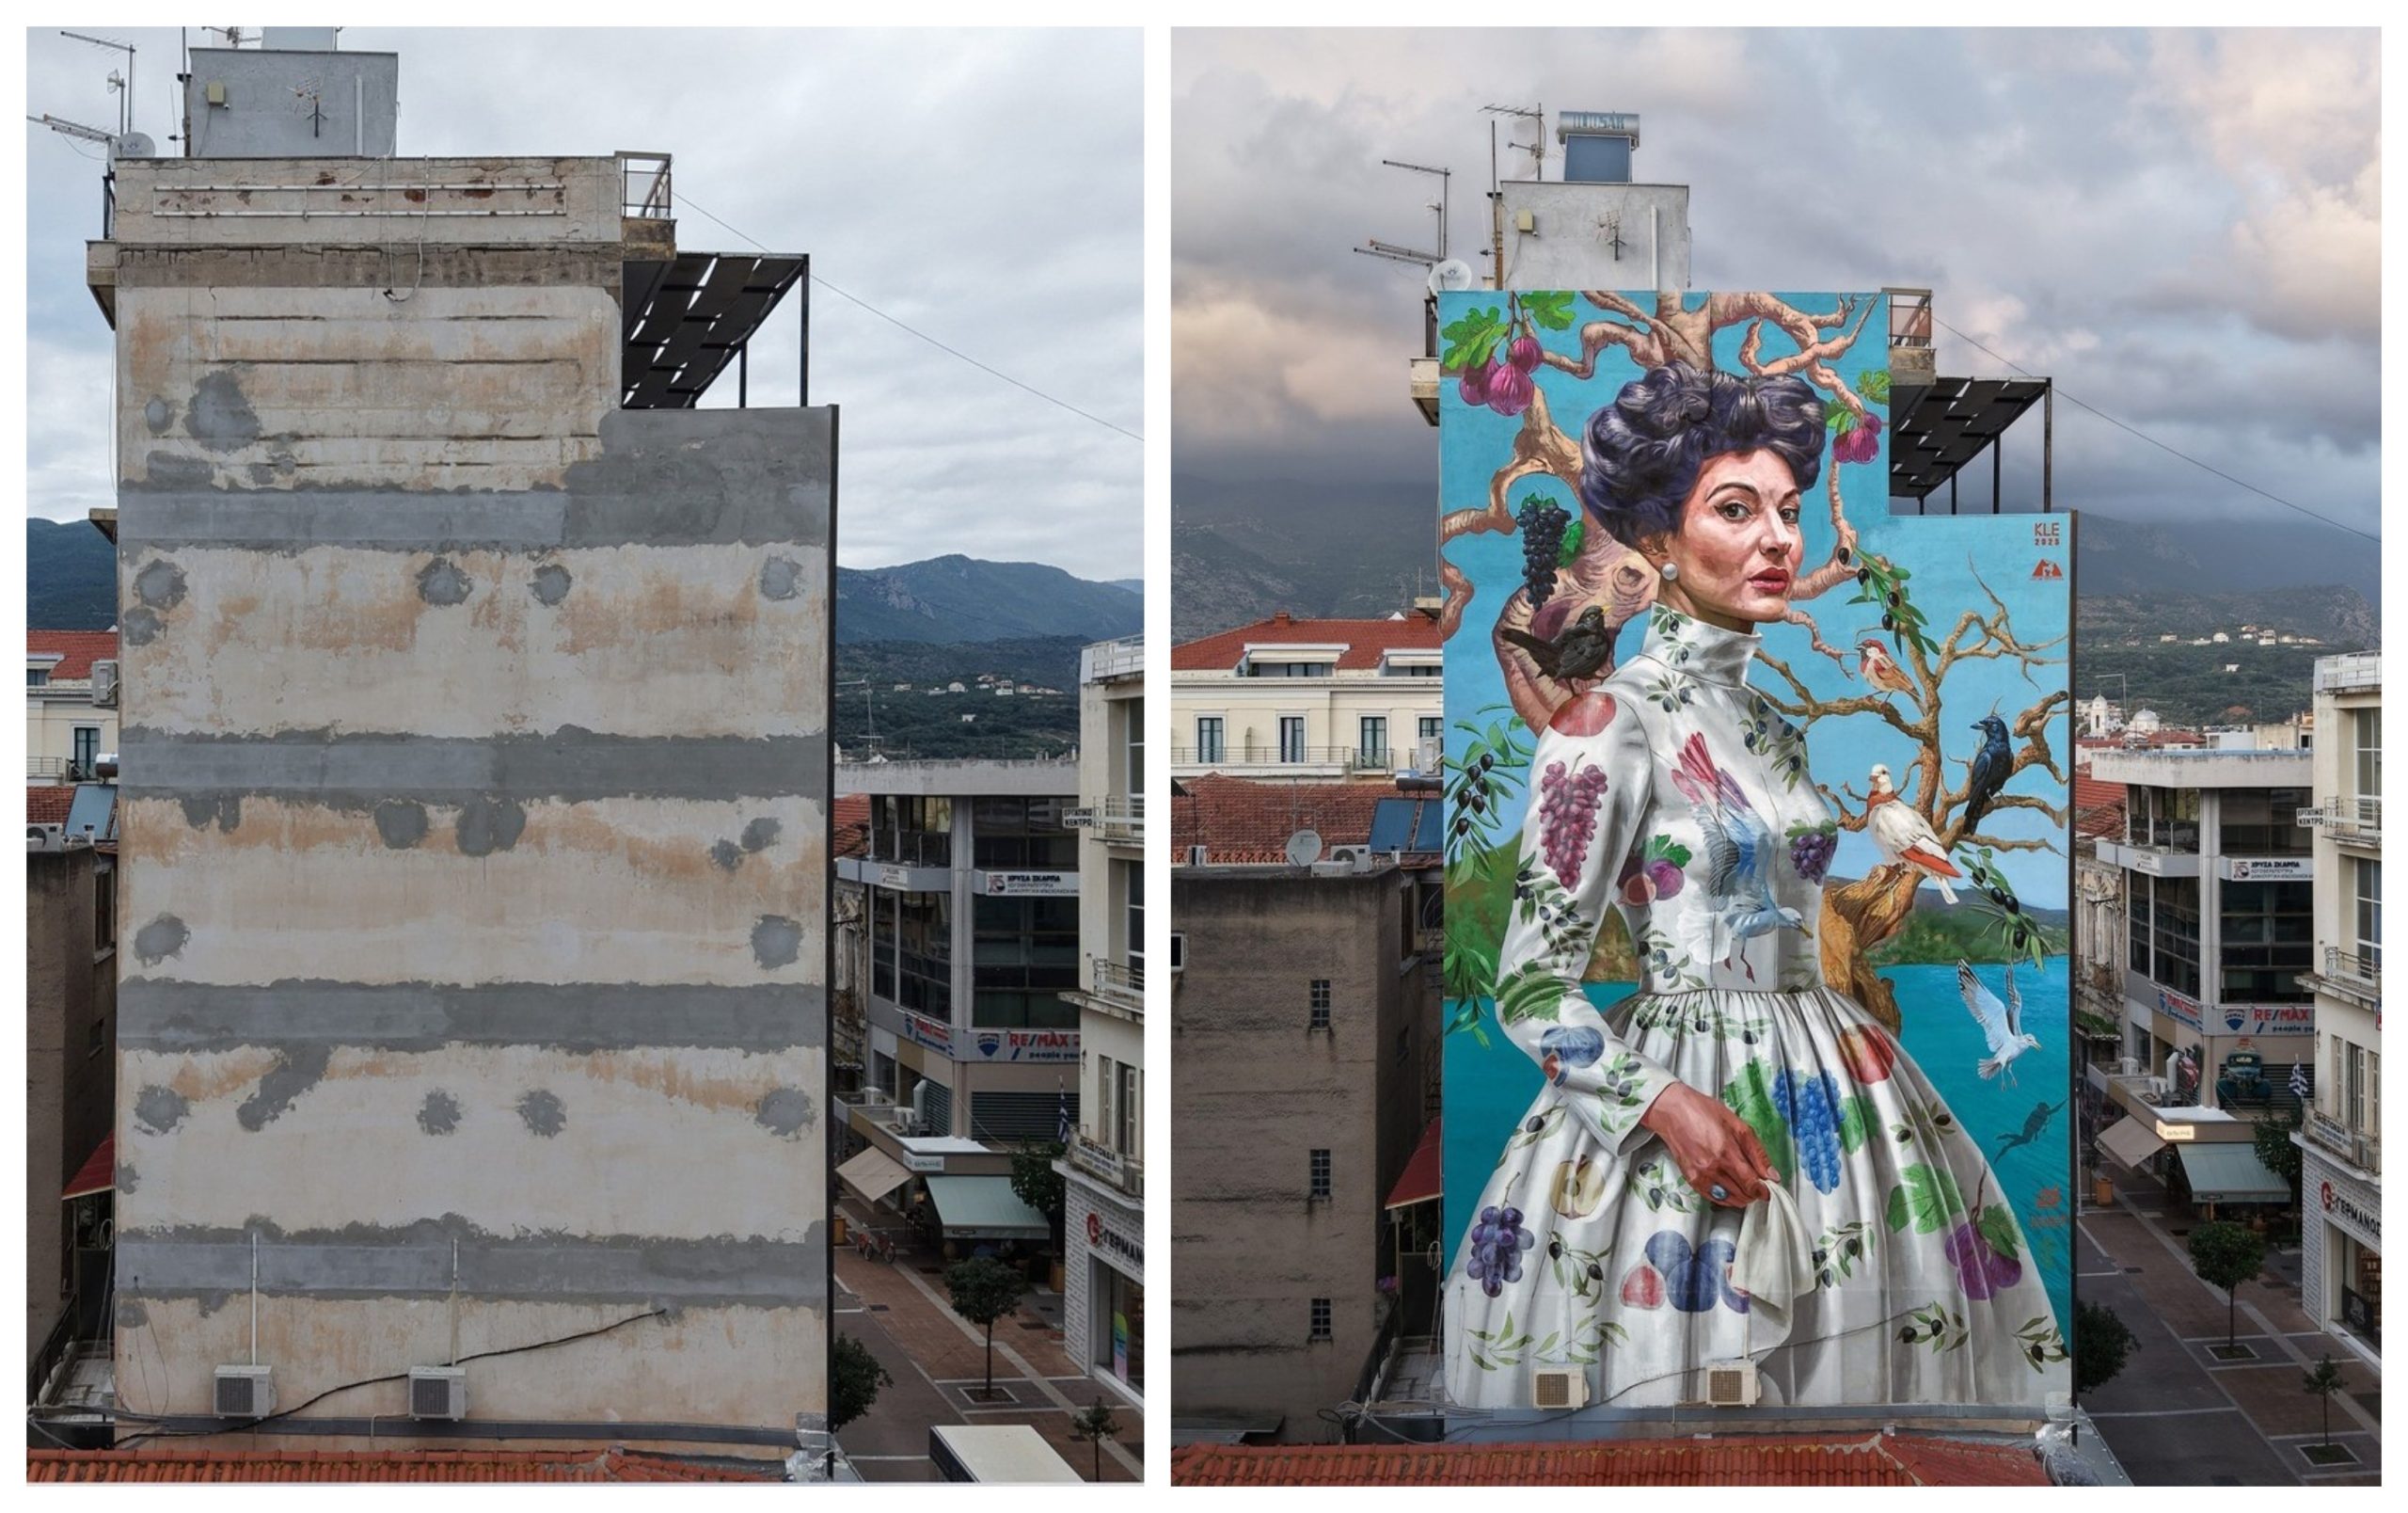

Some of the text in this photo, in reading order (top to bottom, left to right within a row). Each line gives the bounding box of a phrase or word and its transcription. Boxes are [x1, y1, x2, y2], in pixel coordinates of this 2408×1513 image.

[2034, 522, 2060, 536] KLE
[2298, 817, 2323, 825] ΚΕΝΤΡΟ
[2254, 1009, 2310, 1021] RE/MAX
[1008, 1033, 1069, 1047] RE/MAX
[1103, 1228, 1145, 1266] ΓΕΡΜΑΝ
